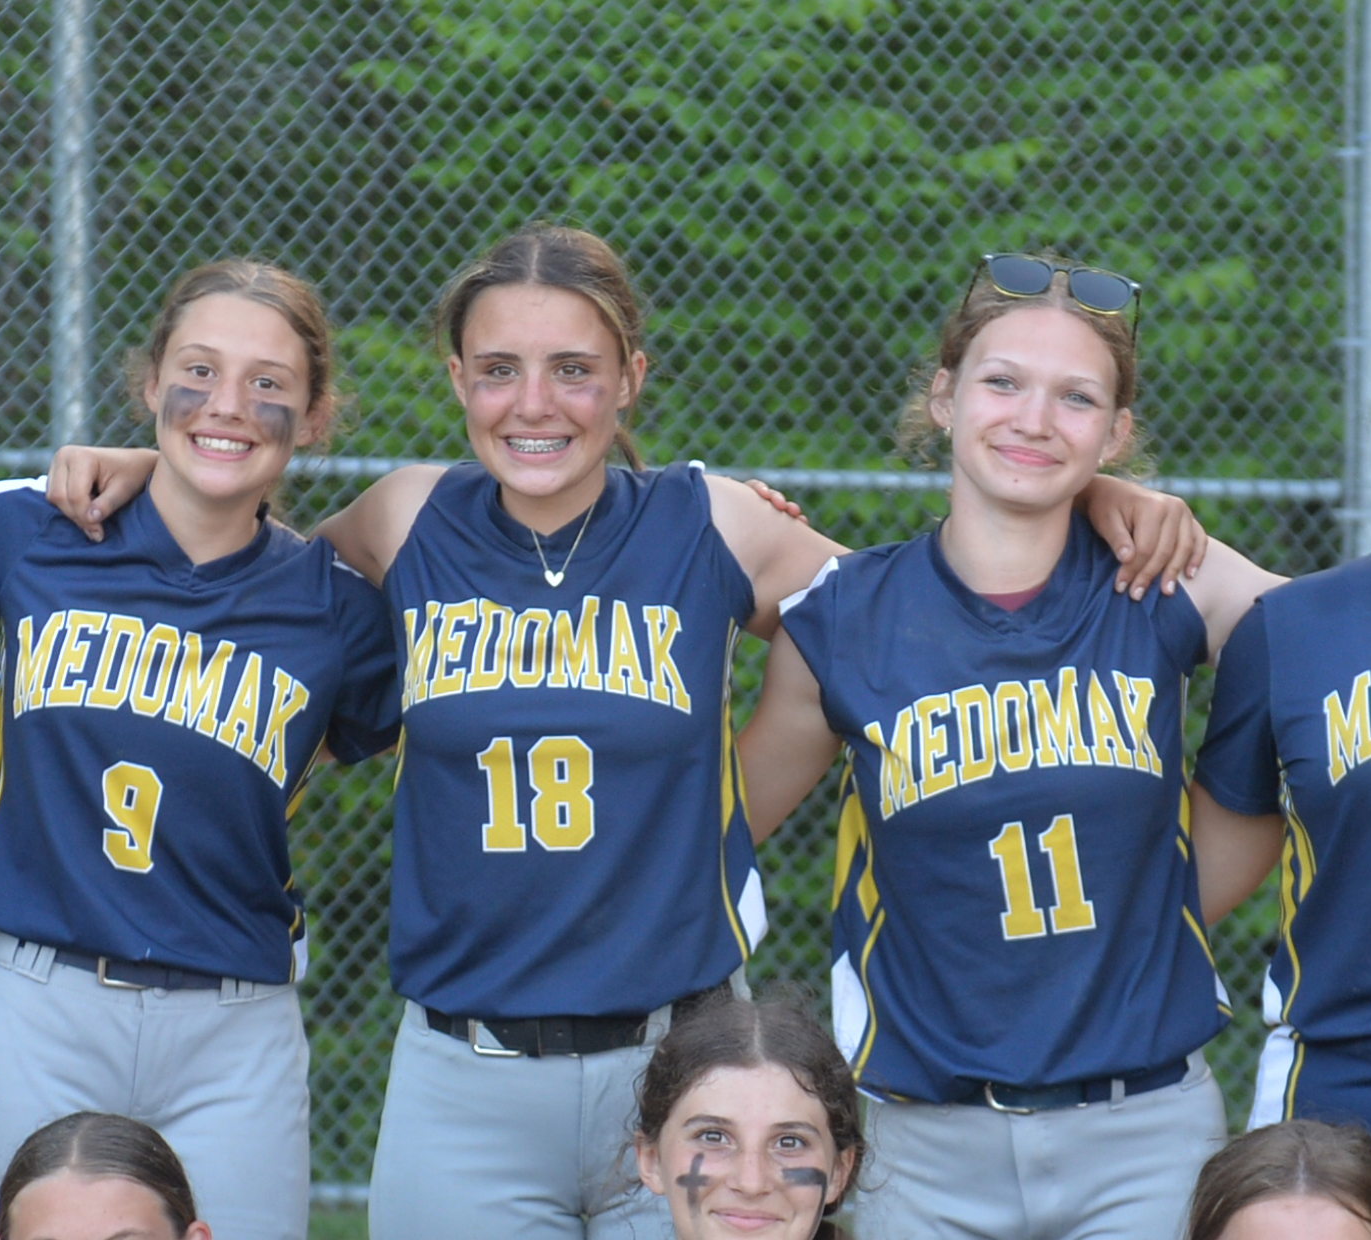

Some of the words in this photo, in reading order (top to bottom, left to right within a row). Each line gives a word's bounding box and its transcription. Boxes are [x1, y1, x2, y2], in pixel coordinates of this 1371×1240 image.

[13, 609, 310, 789] MEDOMAK
[402, 595, 691, 715] MEDOMAK
[477, 735, 595, 851] 18
[864, 666, 1163, 821] MEDOMAK
[102, 760, 163, 873] 9
[988, 813, 1096, 940] 11
